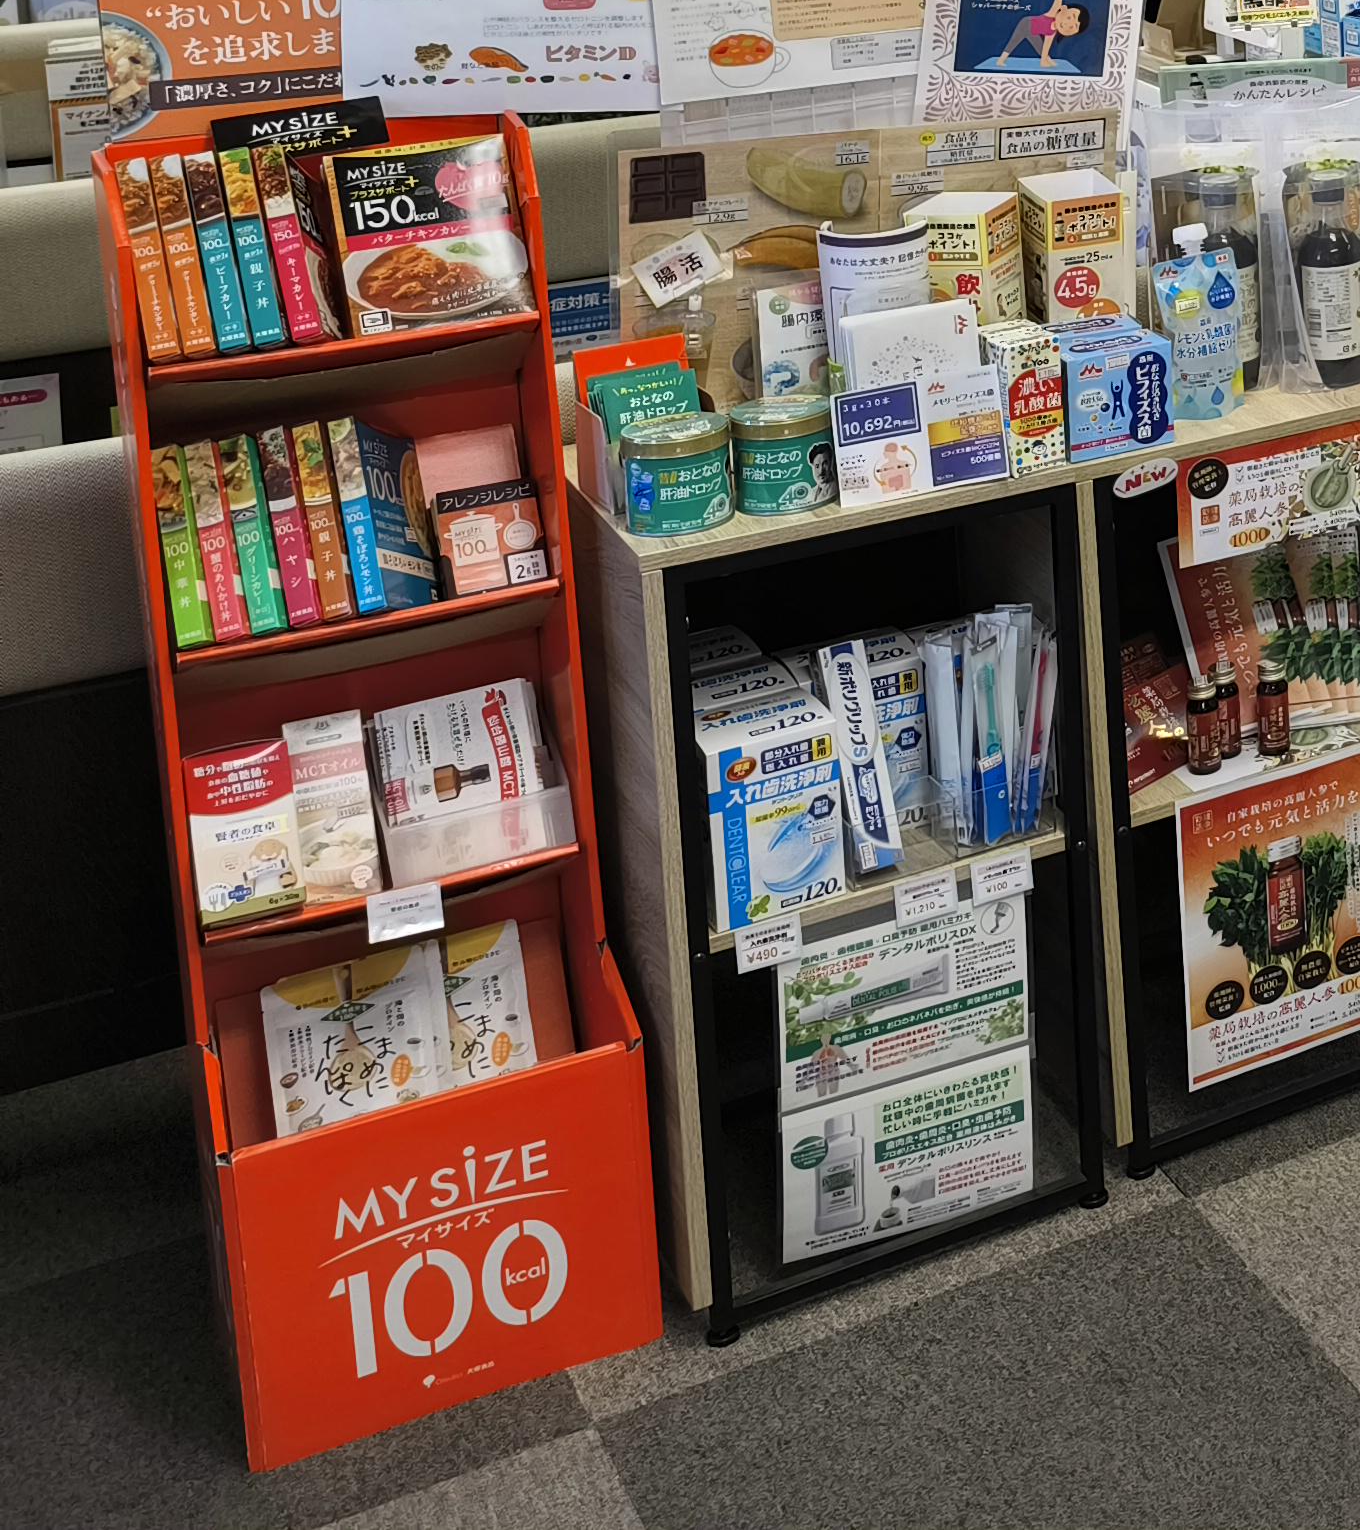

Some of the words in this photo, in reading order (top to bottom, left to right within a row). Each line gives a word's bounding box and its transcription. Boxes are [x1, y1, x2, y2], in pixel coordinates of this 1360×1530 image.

[545, 44, 637, 63] ビタミンD
[943, 131, 980, 145] 食品名
[1005, 131, 1098, 156] 食品の糖質量
[1078, 210, 1105, 222] ココが
[937, 231, 964, 242] ココが
[651, 250, 706, 292] 腸活
[1056, 278, 1098, 300] 4.5g
[628, 390, 675, 409] おとなの
[1013, 394, 1062, 417] 乳酸菌
[619, 400, 688, 425] 肝油ドロップ
[753, 450, 802, 466] おとなの
[677, 461, 722, 481] おとなの
[741, 465, 802, 482] 肝油ドロップ
[1124, 465, 1168, 491] NEW
[440, 482, 530, 511] アレンジレシピ
[659, 478, 723, 502] 肝油ドロップ
[1228, 480, 1300, 508] 薬局栽培の
[1228, 500, 1290, 529] 高麗人参
[1231, 526, 1270, 548] 1000
[725, 763, 833, 810] 入れ歯洗浄剤
[1225, 779, 1340, 824] 自家栽培の高麗人参で
[1205, 789, 1360, 849] いつでも元気と活力を
[985, 880, 1009, 894] ¥100
[905, 901, 936, 918] ¥1,210
[746, 946, 779, 964] ¥490
[878, 925, 978, 961] デンタルポリスDX
[896, 1132, 993, 1169] デンタルポリスリンス
[395, 1208, 495, 1251] マイサイズ
[503, 1257, 548, 1288] kcal
[328, 1218, 570, 1380] 100
